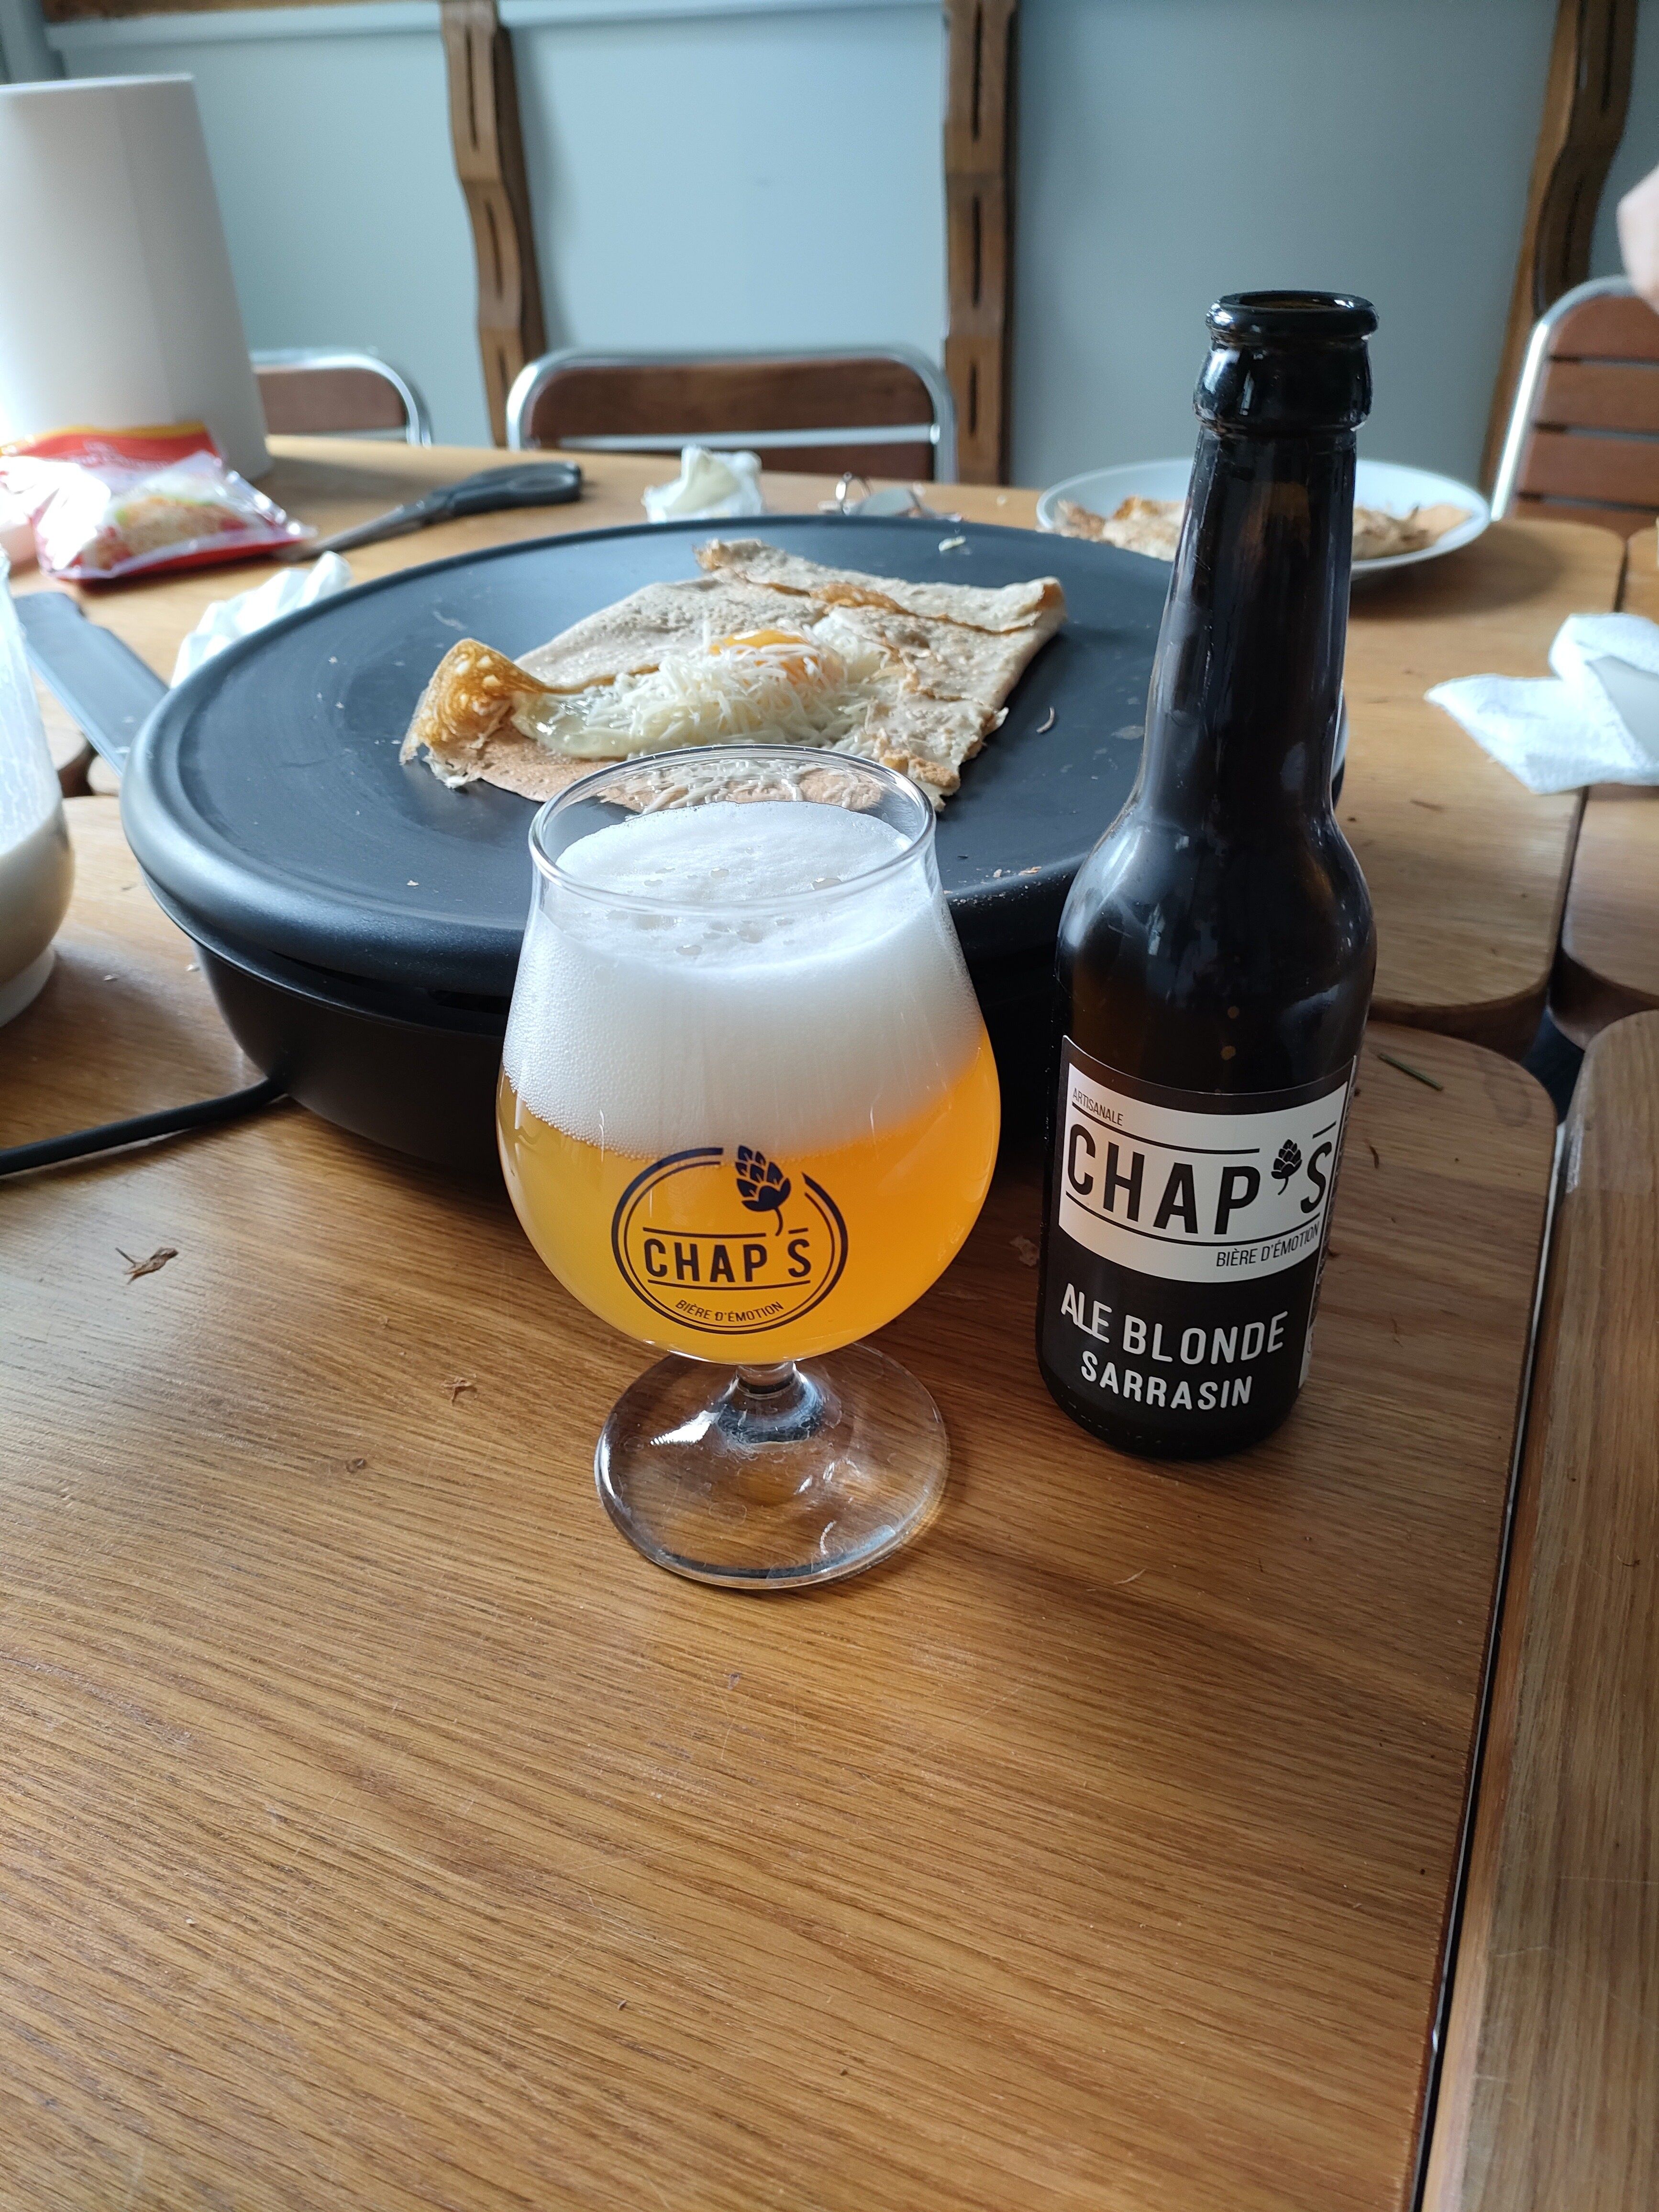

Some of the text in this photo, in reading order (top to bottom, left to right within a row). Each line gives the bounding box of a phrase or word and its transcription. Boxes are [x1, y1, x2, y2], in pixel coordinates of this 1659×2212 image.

[1072, 1087, 1123, 1127] ARTISANALE
[1217, 1221, 1320, 1267] BIÈRE D'ÉMOTION
[675, 1299, 784, 1322] BIÈRE D'ÉMOTION
[1061, 1283, 1112, 1343] ALE
[1123, 1311, 1288, 1364] BLONDE
[1081, 1351, 1252, 1410] SARRASIN
